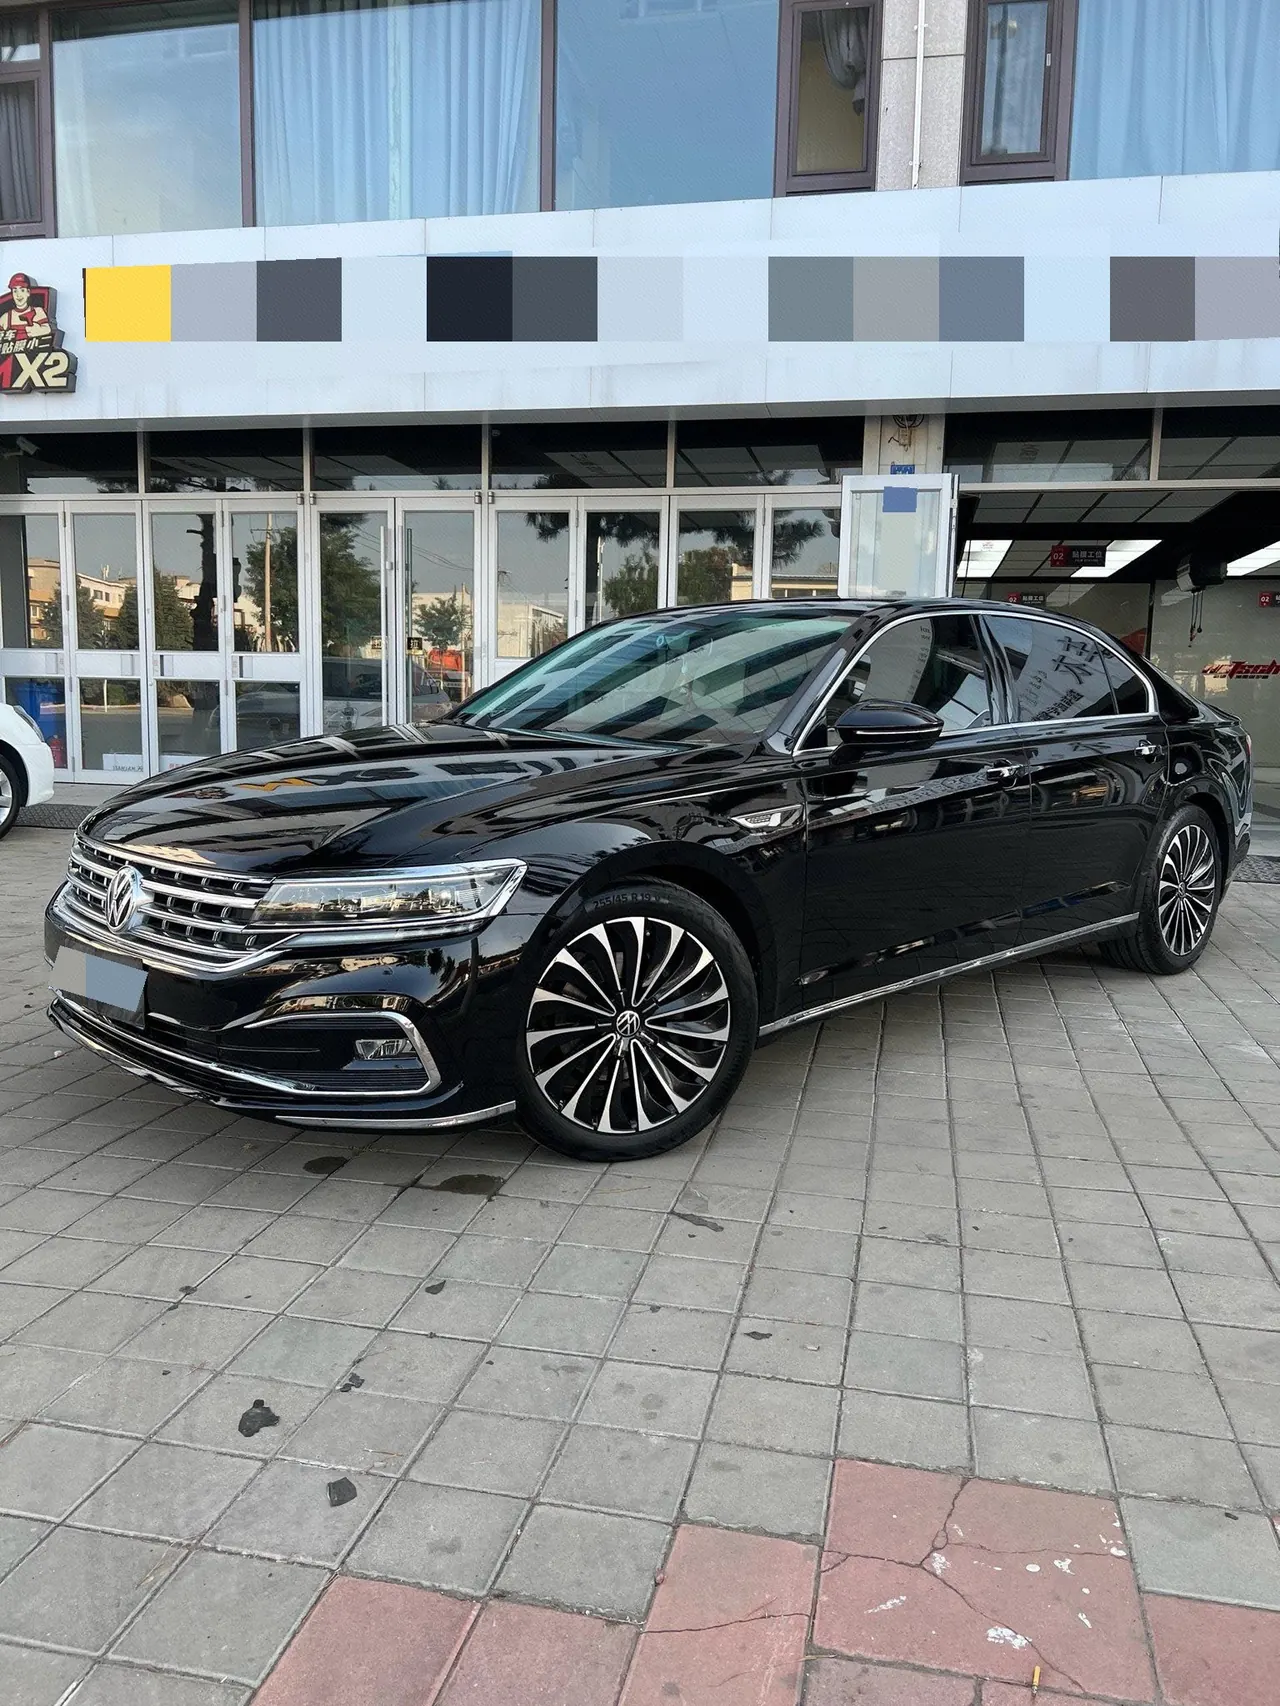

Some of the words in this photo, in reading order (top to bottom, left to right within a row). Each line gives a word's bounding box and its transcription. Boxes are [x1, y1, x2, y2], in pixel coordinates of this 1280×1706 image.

[0, 336, 52, 354] 贴膜小二
[1053, 552, 1064, 560] 02
[1260, 595, 1270, 603] 02
